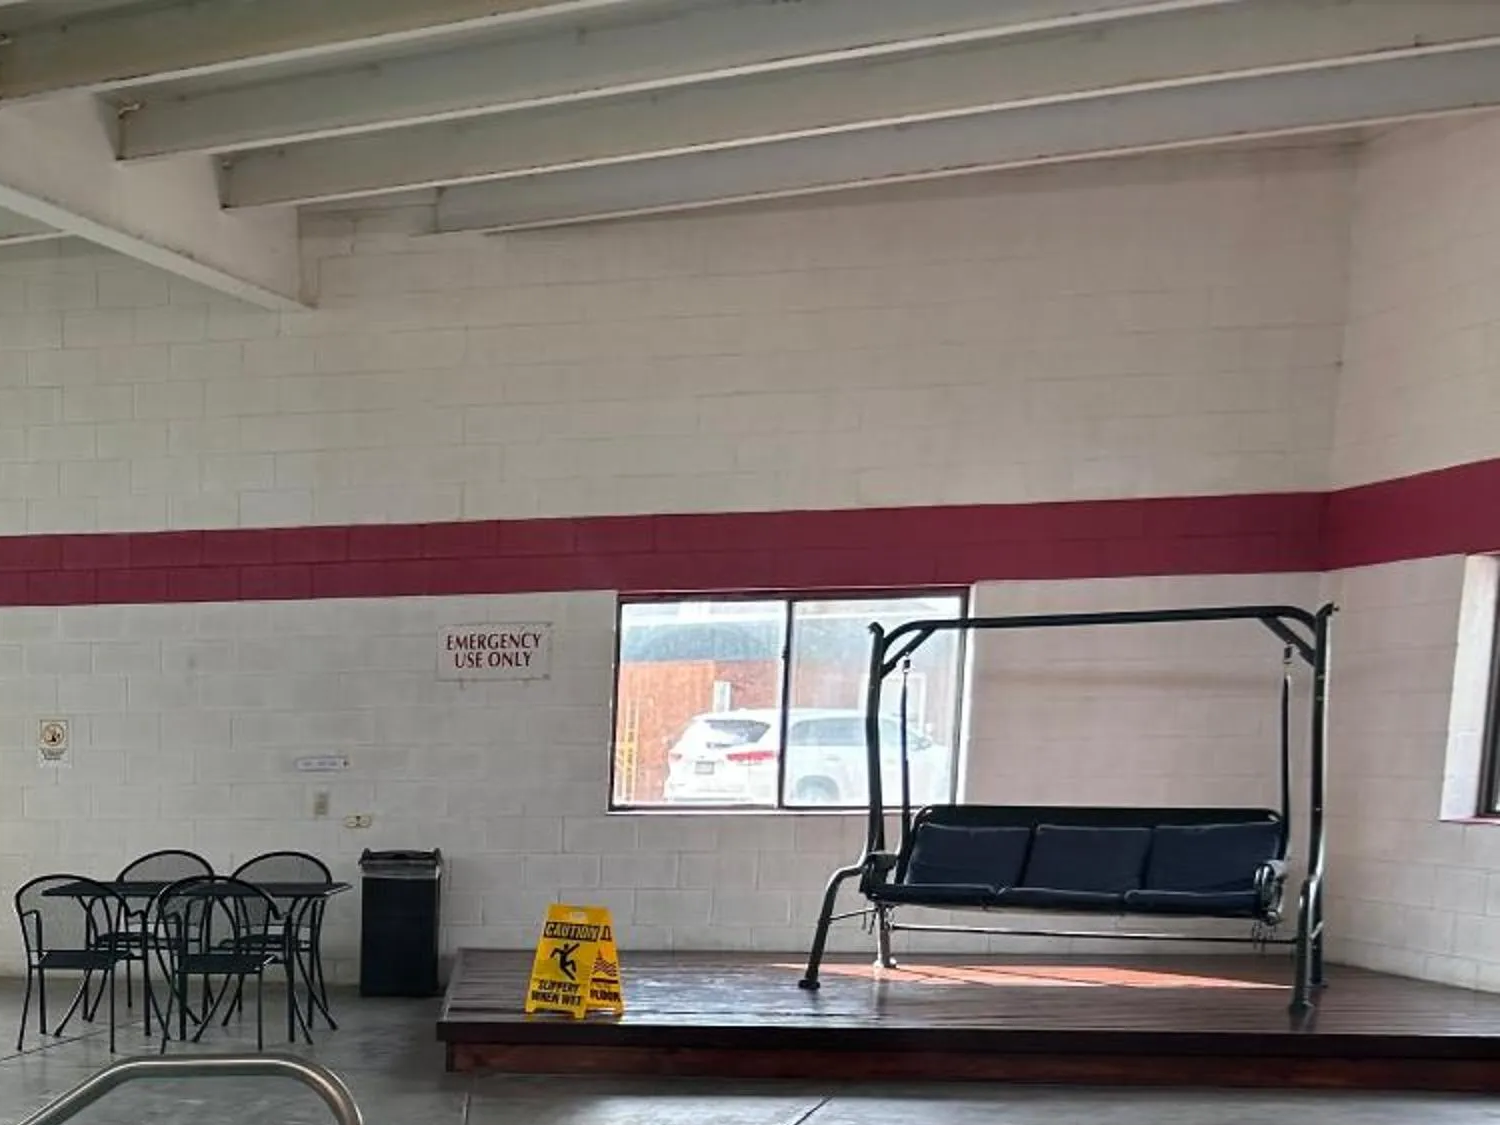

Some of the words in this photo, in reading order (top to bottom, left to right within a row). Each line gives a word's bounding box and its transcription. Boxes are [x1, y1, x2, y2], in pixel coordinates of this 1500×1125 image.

[446, 633, 541, 650] EMERGENCY
[455, 652, 483, 669] USE
[488, 651, 532, 668] ONLY
[544, 922, 599, 941] CAUTION
